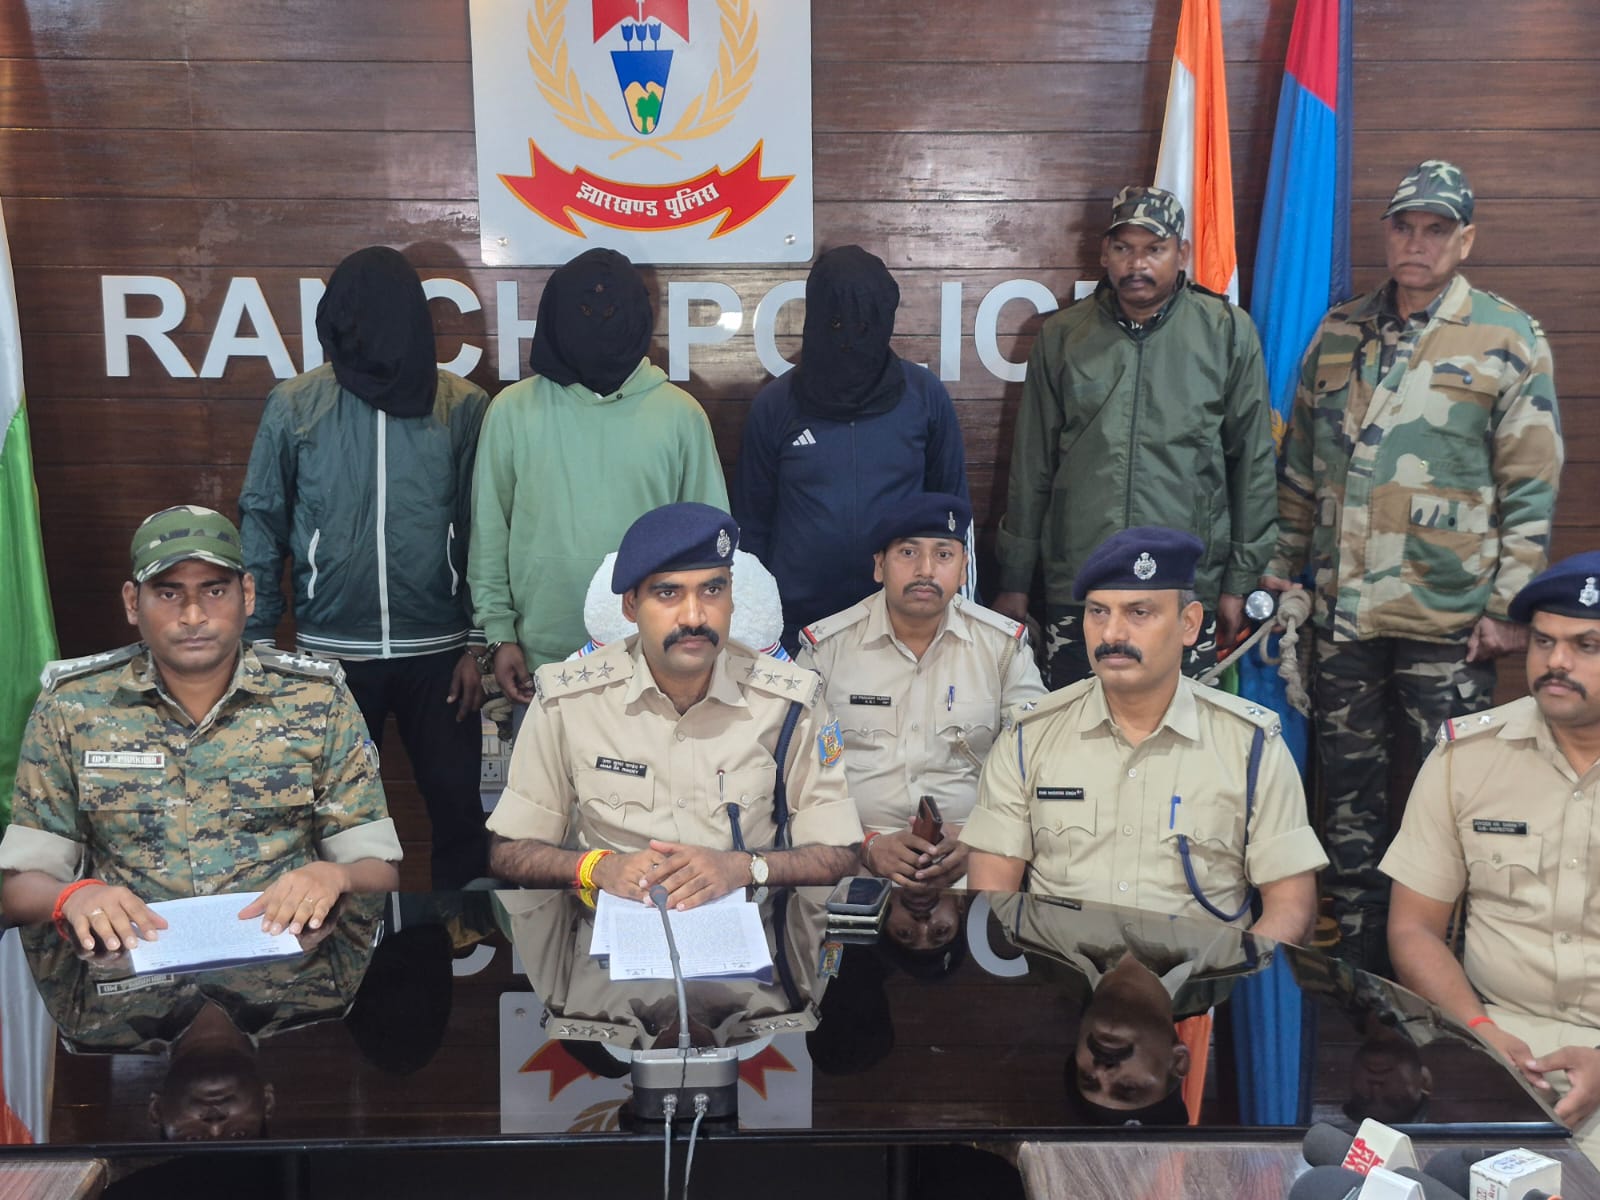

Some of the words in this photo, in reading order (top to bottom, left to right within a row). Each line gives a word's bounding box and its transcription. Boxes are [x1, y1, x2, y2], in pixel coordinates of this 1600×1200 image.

[575, 181, 658, 216] झारखण्ड
[664, 182, 721, 219] पुलिस
[667, 279, 1099, 382] POIC
